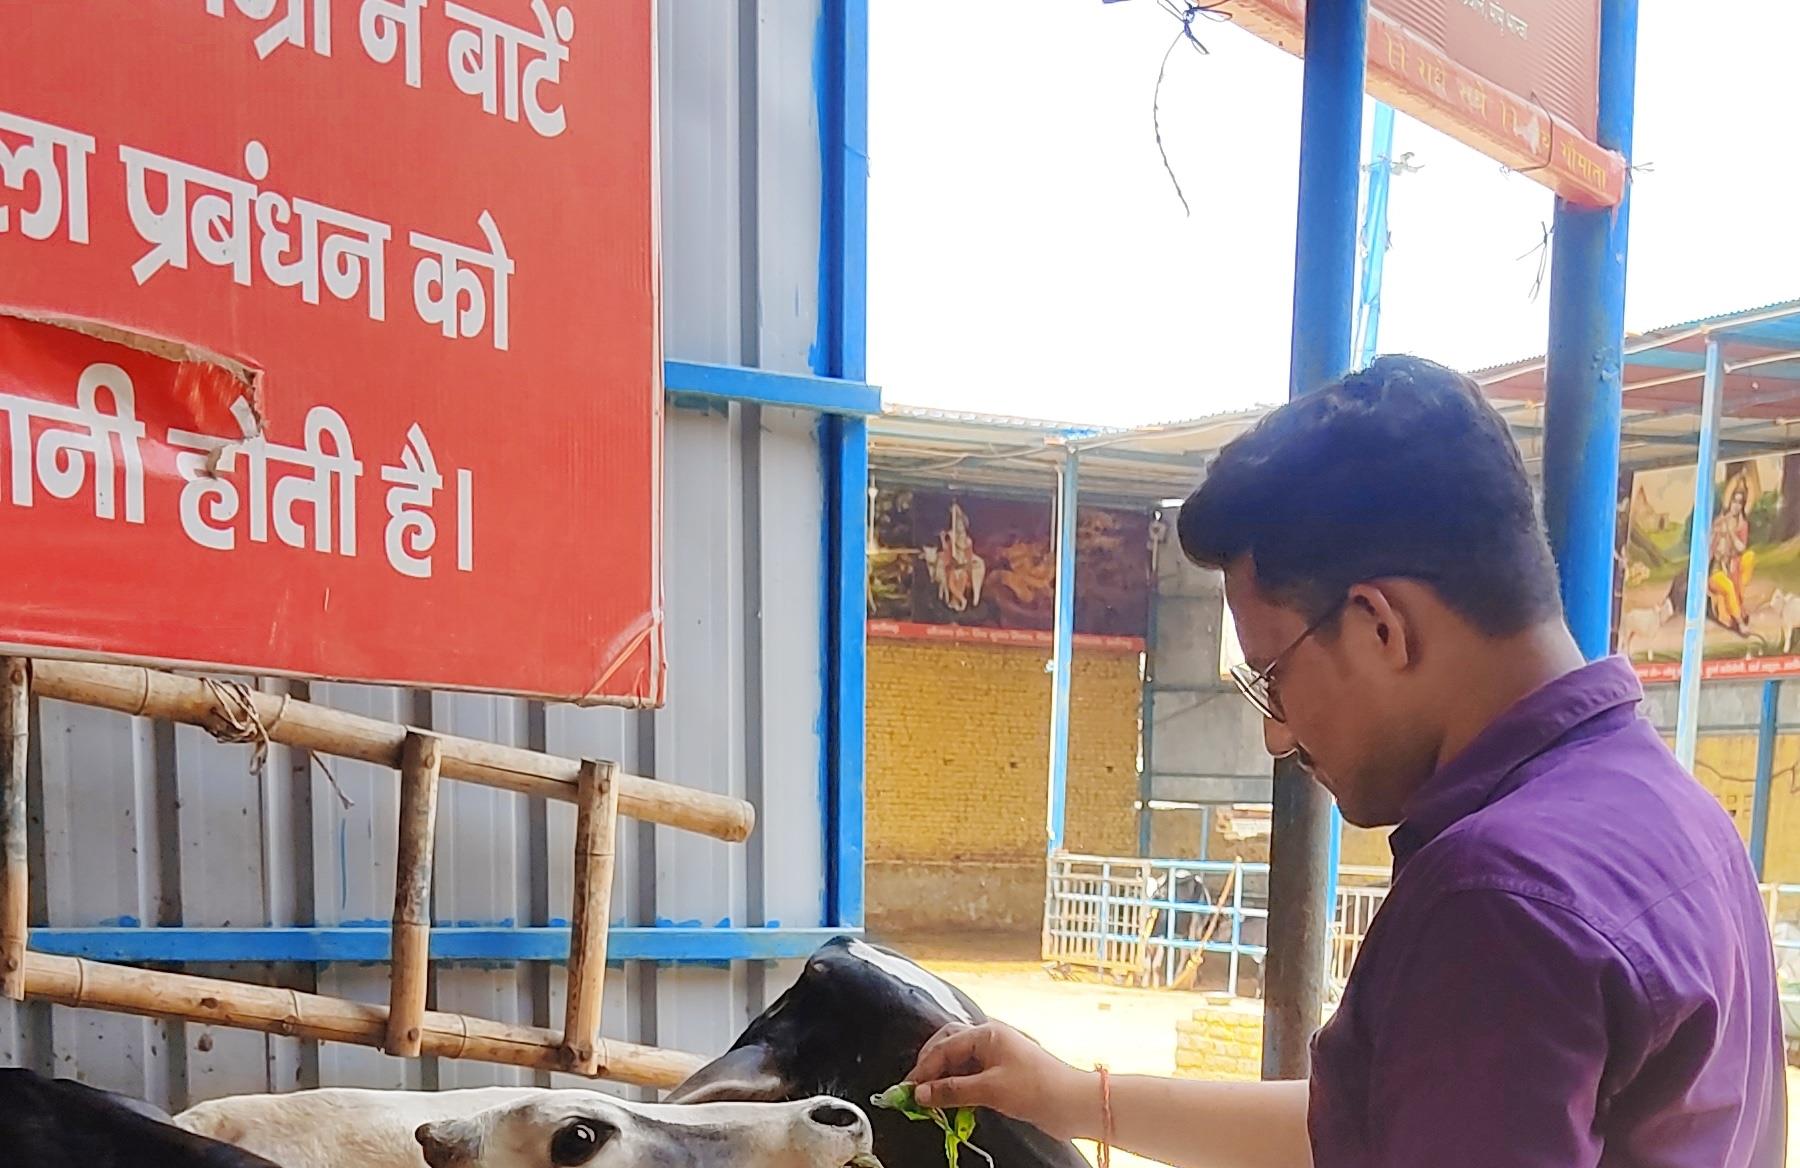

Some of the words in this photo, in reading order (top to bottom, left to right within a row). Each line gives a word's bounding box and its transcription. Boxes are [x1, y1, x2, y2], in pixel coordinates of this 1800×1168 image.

[444, 0, 575, 138] बाटें
[118, 140, 391, 322] प्रबंधन
[410, 209, 515, 351] को
[167, 395, 363, 558] होती
